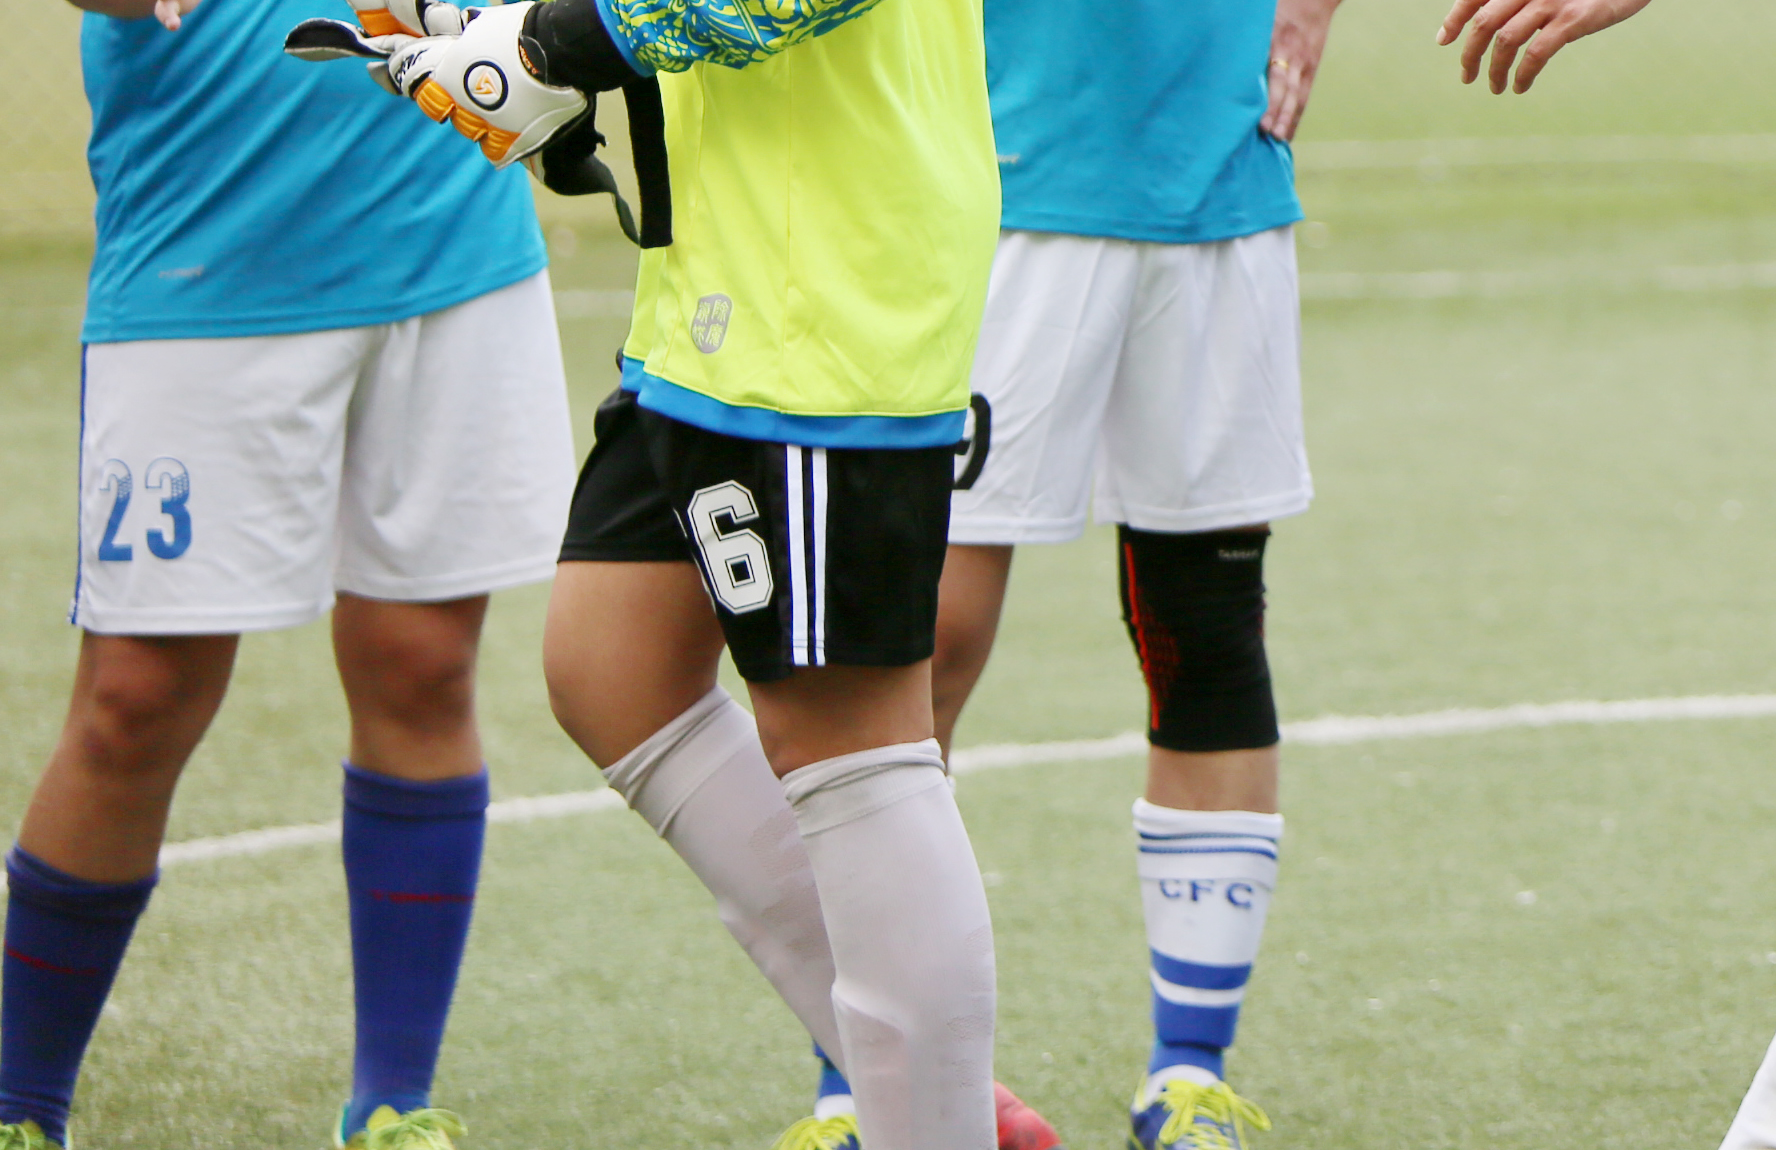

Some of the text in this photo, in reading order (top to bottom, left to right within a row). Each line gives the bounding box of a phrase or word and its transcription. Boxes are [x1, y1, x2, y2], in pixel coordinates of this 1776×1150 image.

[98, 456, 193, 561] 23
[673, 480, 774, 615] 6
[1159, 878, 1253, 910] CFC
